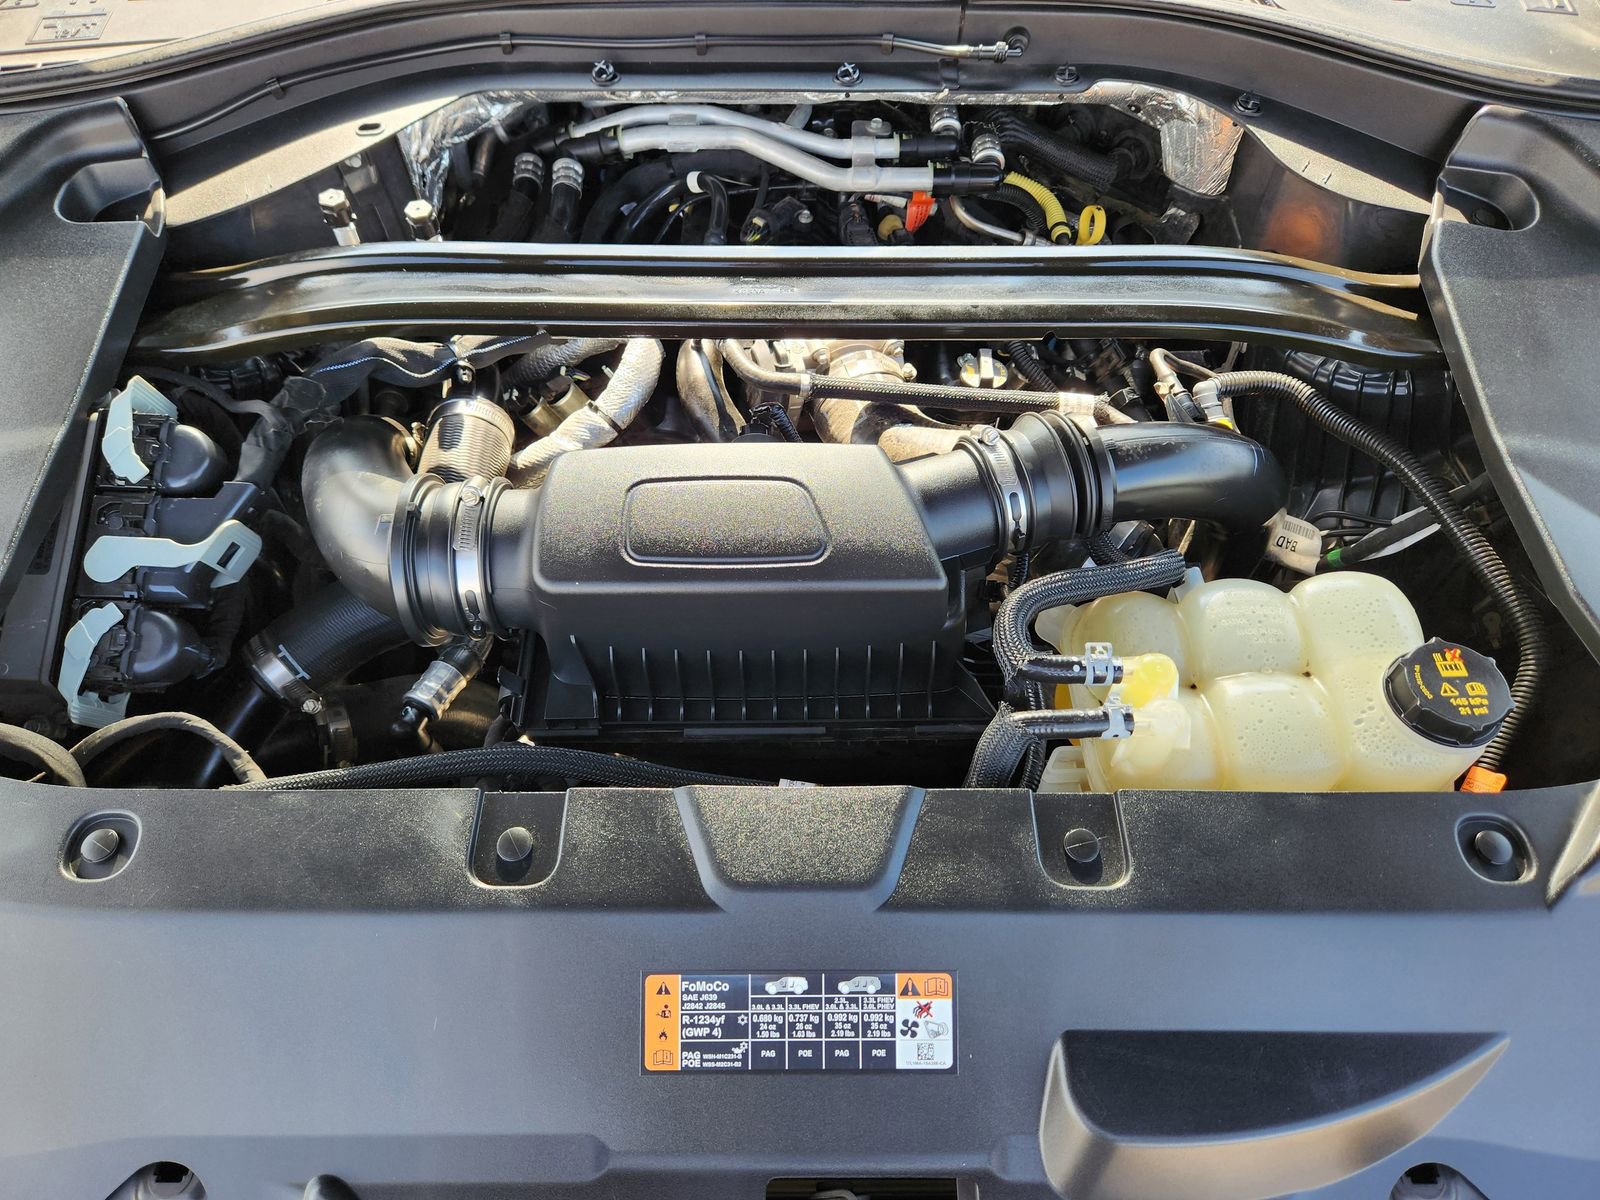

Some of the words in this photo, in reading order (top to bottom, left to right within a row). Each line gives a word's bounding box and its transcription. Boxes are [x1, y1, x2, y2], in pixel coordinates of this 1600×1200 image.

[1276, 535, 1298, 552] BAD
[1450, 698, 1468, 706] 145
[1468, 697, 1488, 706] kPa
[1459, 707, 1471, 715] 21
[1473, 707, 1488, 716] psi
[682, 981, 730, 992] FoMoCo
[682, 993, 698, 1001] SAE
[700, 993, 717, 1001] J639
[682, 1015, 726, 1026] R-1234yf
[773, 1014, 783, 1024] kg
[788, 1014, 808, 1022] 0.737
[809, 1014, 819, 1024] kg
[827, 1013, 847, 1022] 0.992
[849, 1013, 858, 1024] kg
[863, 1013, 883, 1022] 0.992
[885, 1013, 894, 1024] kg
[682, 1028, 710, 1038] (GWP
[712, 1028, 722, 1038] 4)
[830, 1030, 844, 1038] 2.19
[845, 1030, 855, 1038] lbs
[866, 1030, 880, 1038] 2.19
[881, 1030, 891, 1038] lbs
[682, 1051, 701, 1060] PAG
[760, 1050, 776, 1058] PAG
[798, 1049, 813, 1057] POE
[834, 1049, 850, 1057] PAG
[871, 1049, 887, 1057] POE
[682, 1059, 701, 1068] POE
